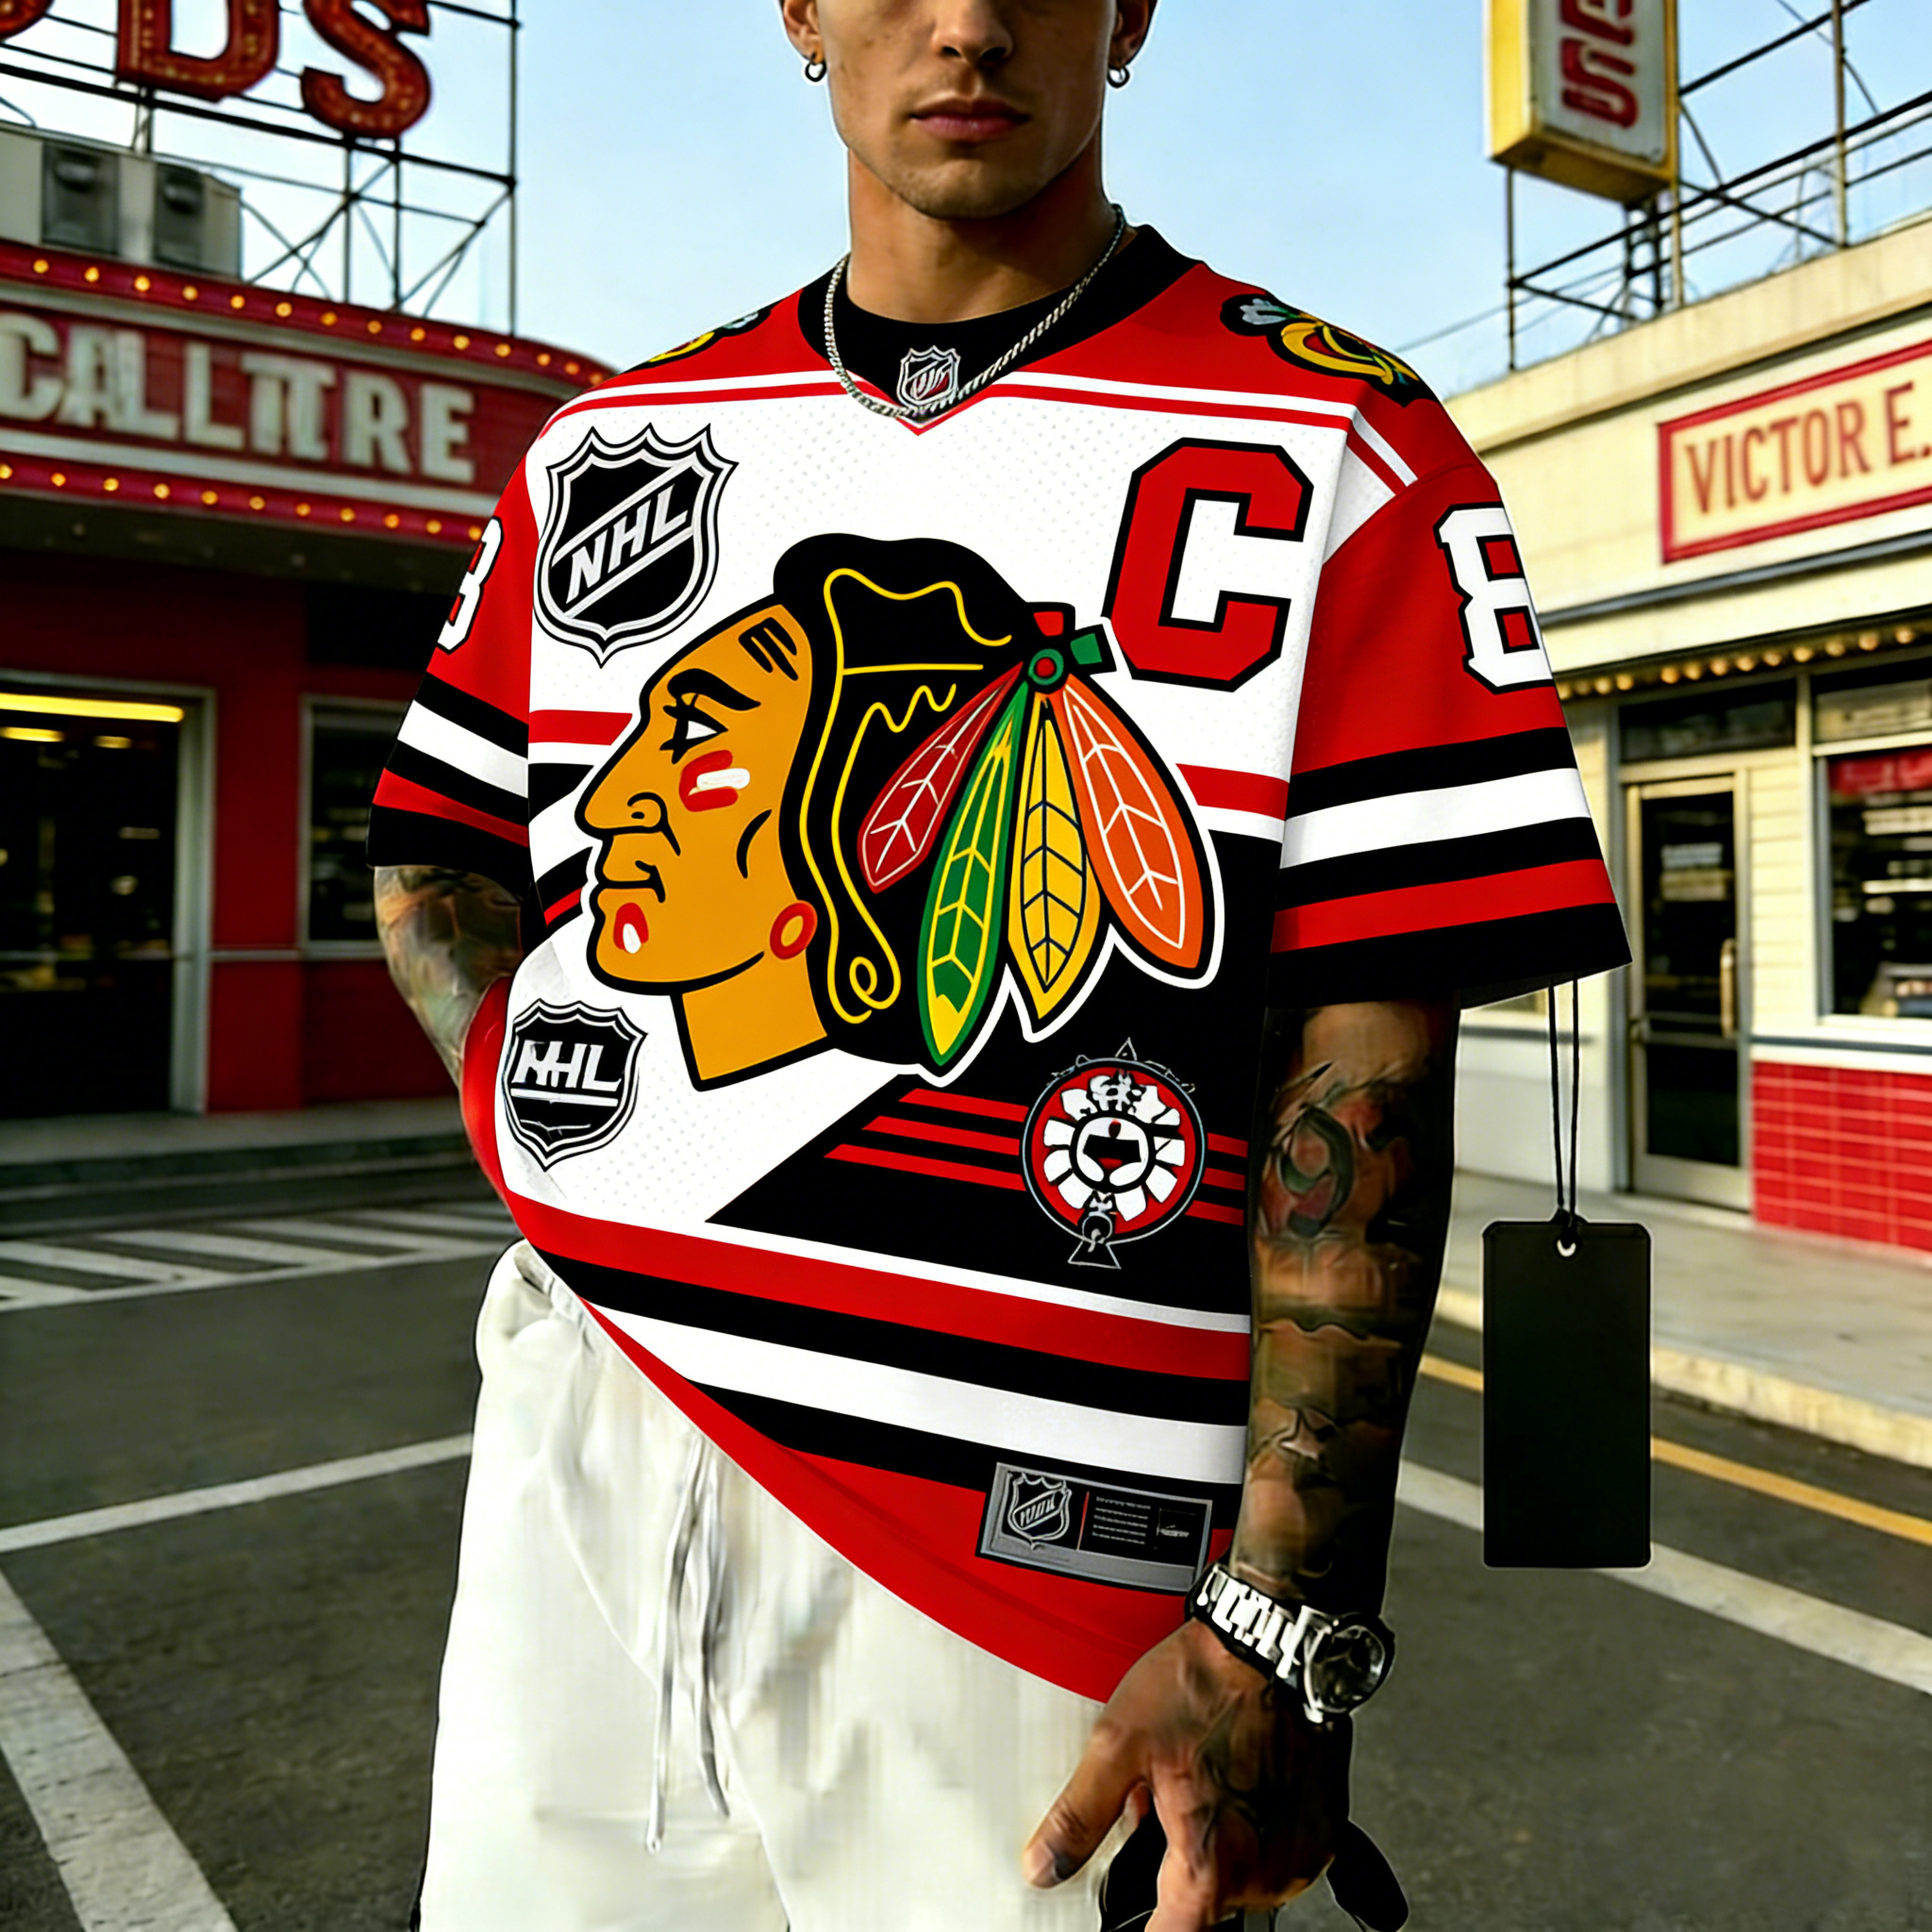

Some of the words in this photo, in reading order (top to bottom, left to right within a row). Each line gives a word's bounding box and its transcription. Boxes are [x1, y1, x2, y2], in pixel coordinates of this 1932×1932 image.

[1686, 401, 1872, 514] VICTOR
[566, 483, 689, 604] NHL
[1102, 437, 1314, 692] C
[1433, 501, 1555, 695] 8
